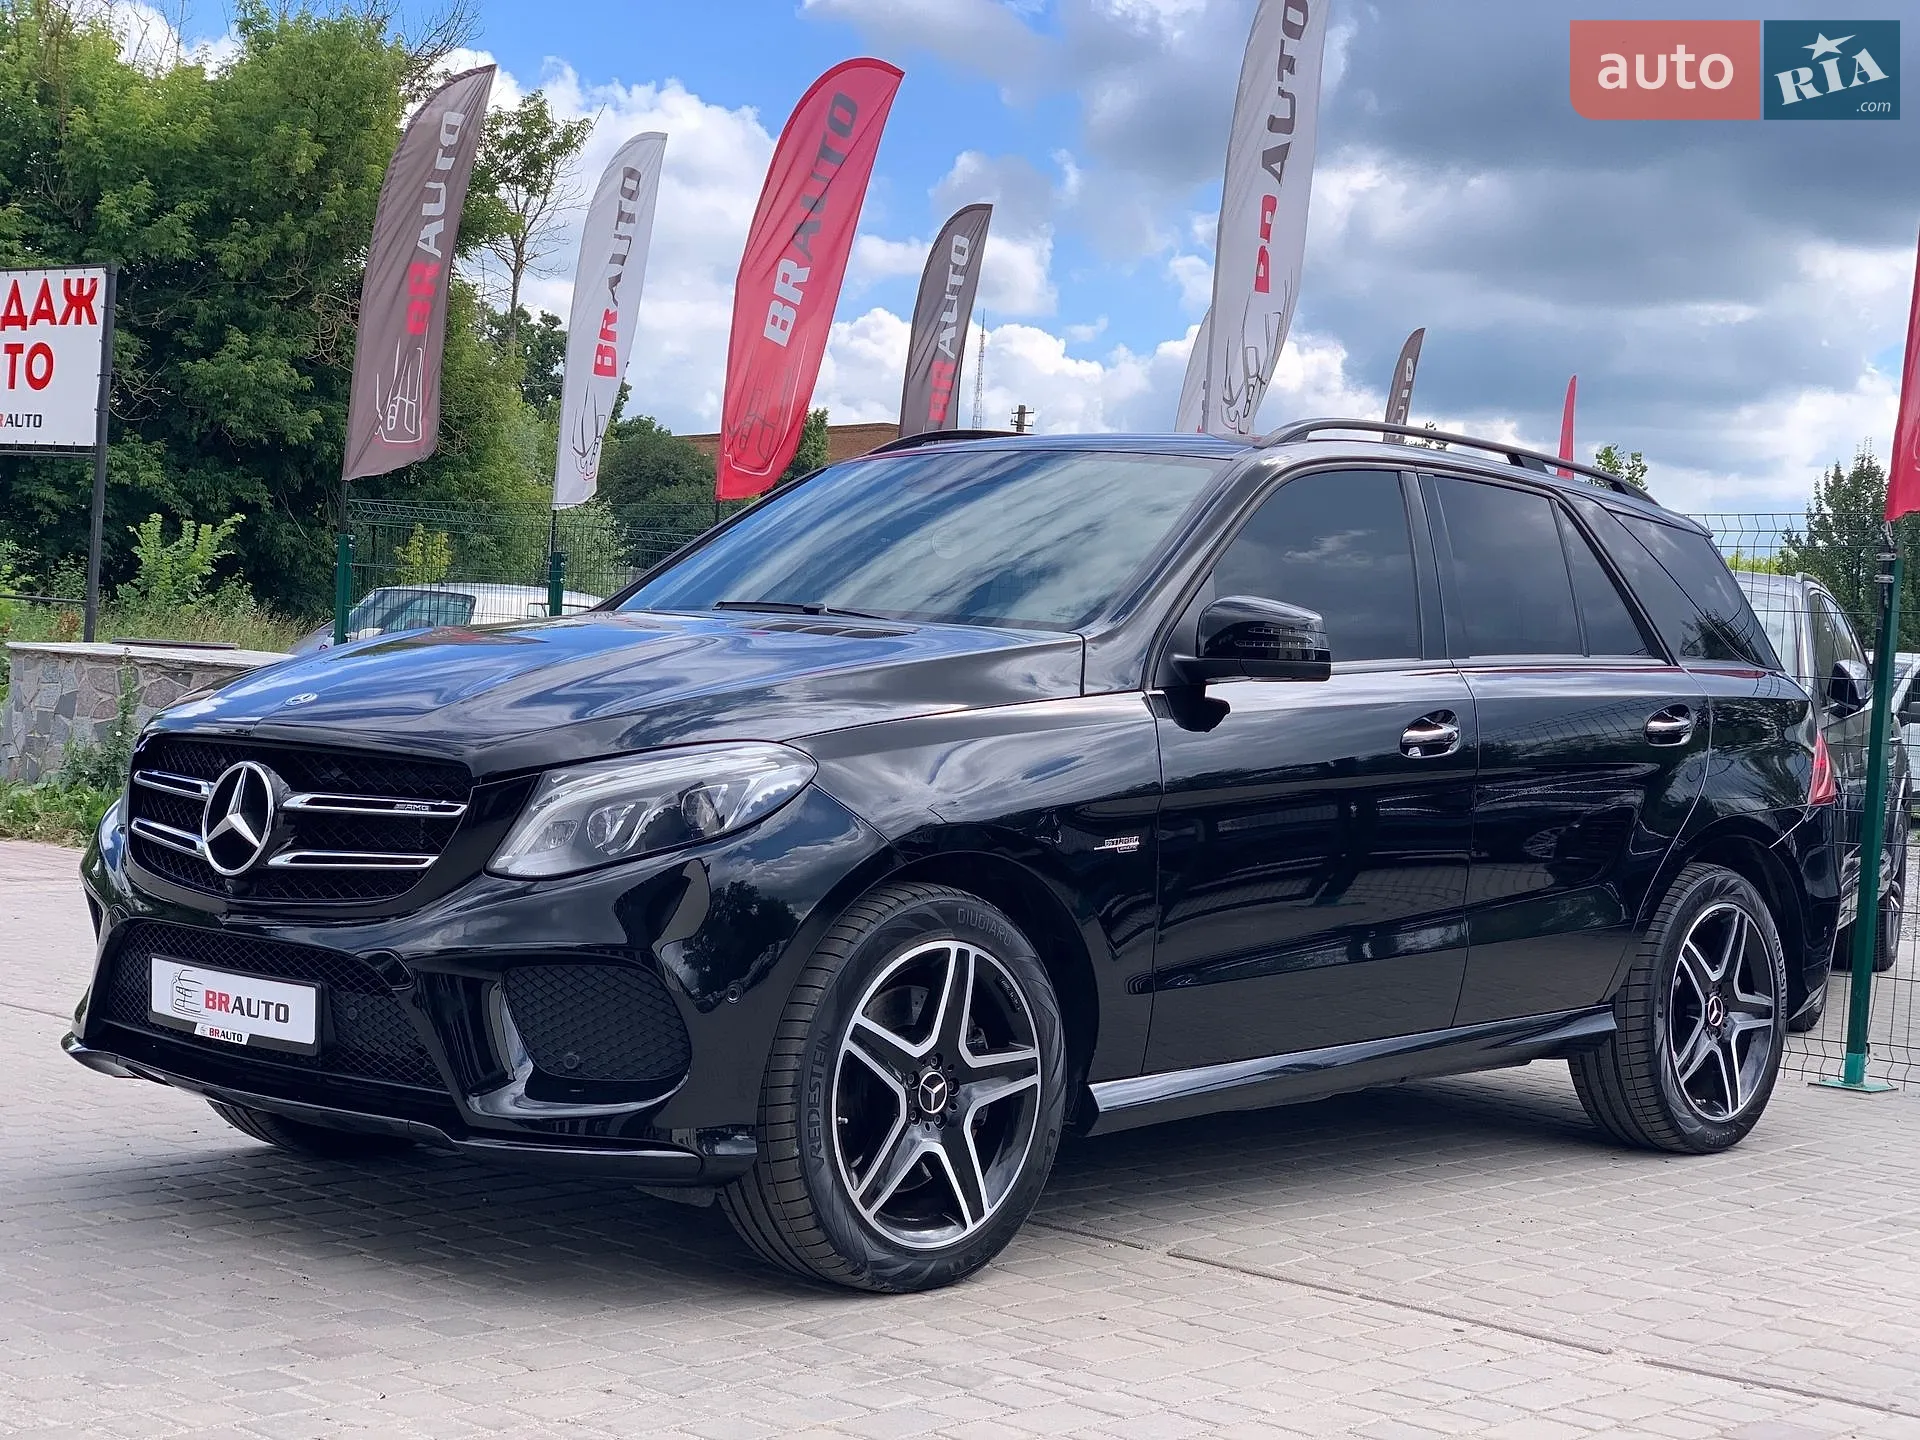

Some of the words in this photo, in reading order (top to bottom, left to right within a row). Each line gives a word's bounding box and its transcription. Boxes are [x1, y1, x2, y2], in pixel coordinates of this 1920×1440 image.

[406, 111, 465, 336] BRAUTO
[762, 91, 858, 347] BRAUTO
[0, 277, 98, 332] ДАЖ
[928, 233, 971, 428] BRAUTO
[204, 989, 290, 1024] BRAUTO
[208, 1027, 243, 1043] BRAUTO
